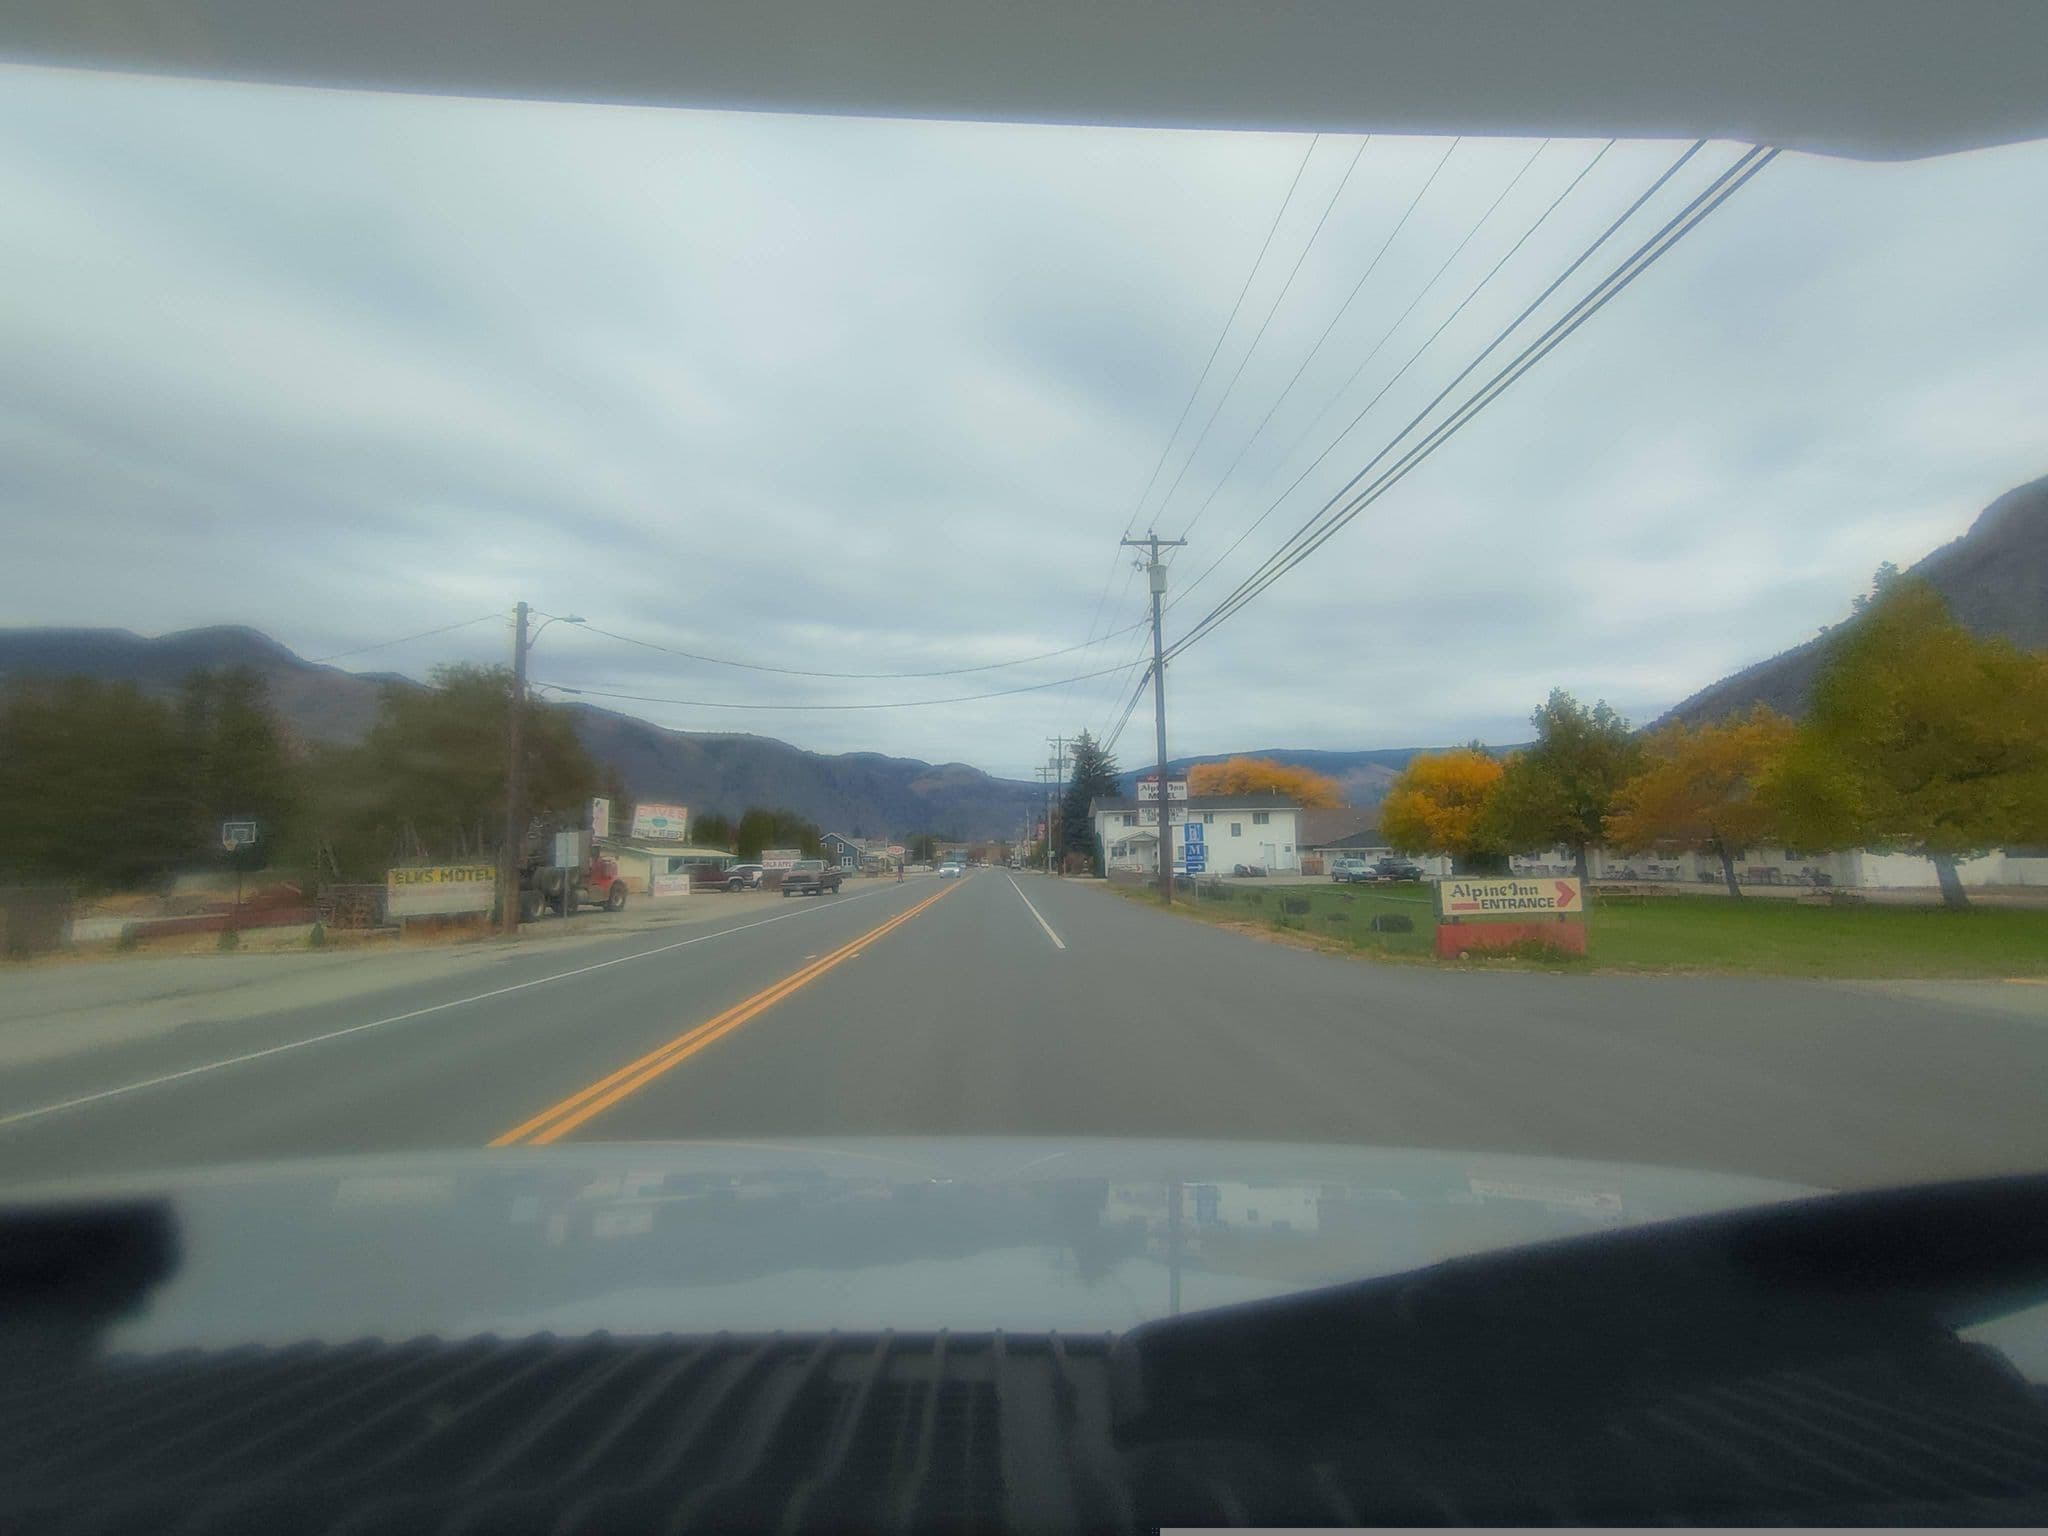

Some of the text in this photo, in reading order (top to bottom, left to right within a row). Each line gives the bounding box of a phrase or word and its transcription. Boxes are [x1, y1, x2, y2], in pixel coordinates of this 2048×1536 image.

[1189, 845, 1200, 854] M
[441, 867, 494, 881] MOTEL
[1451, 882, 1539, 901] Alpine Inn
[1481, 898, 1554, 909] ENTRANCE
